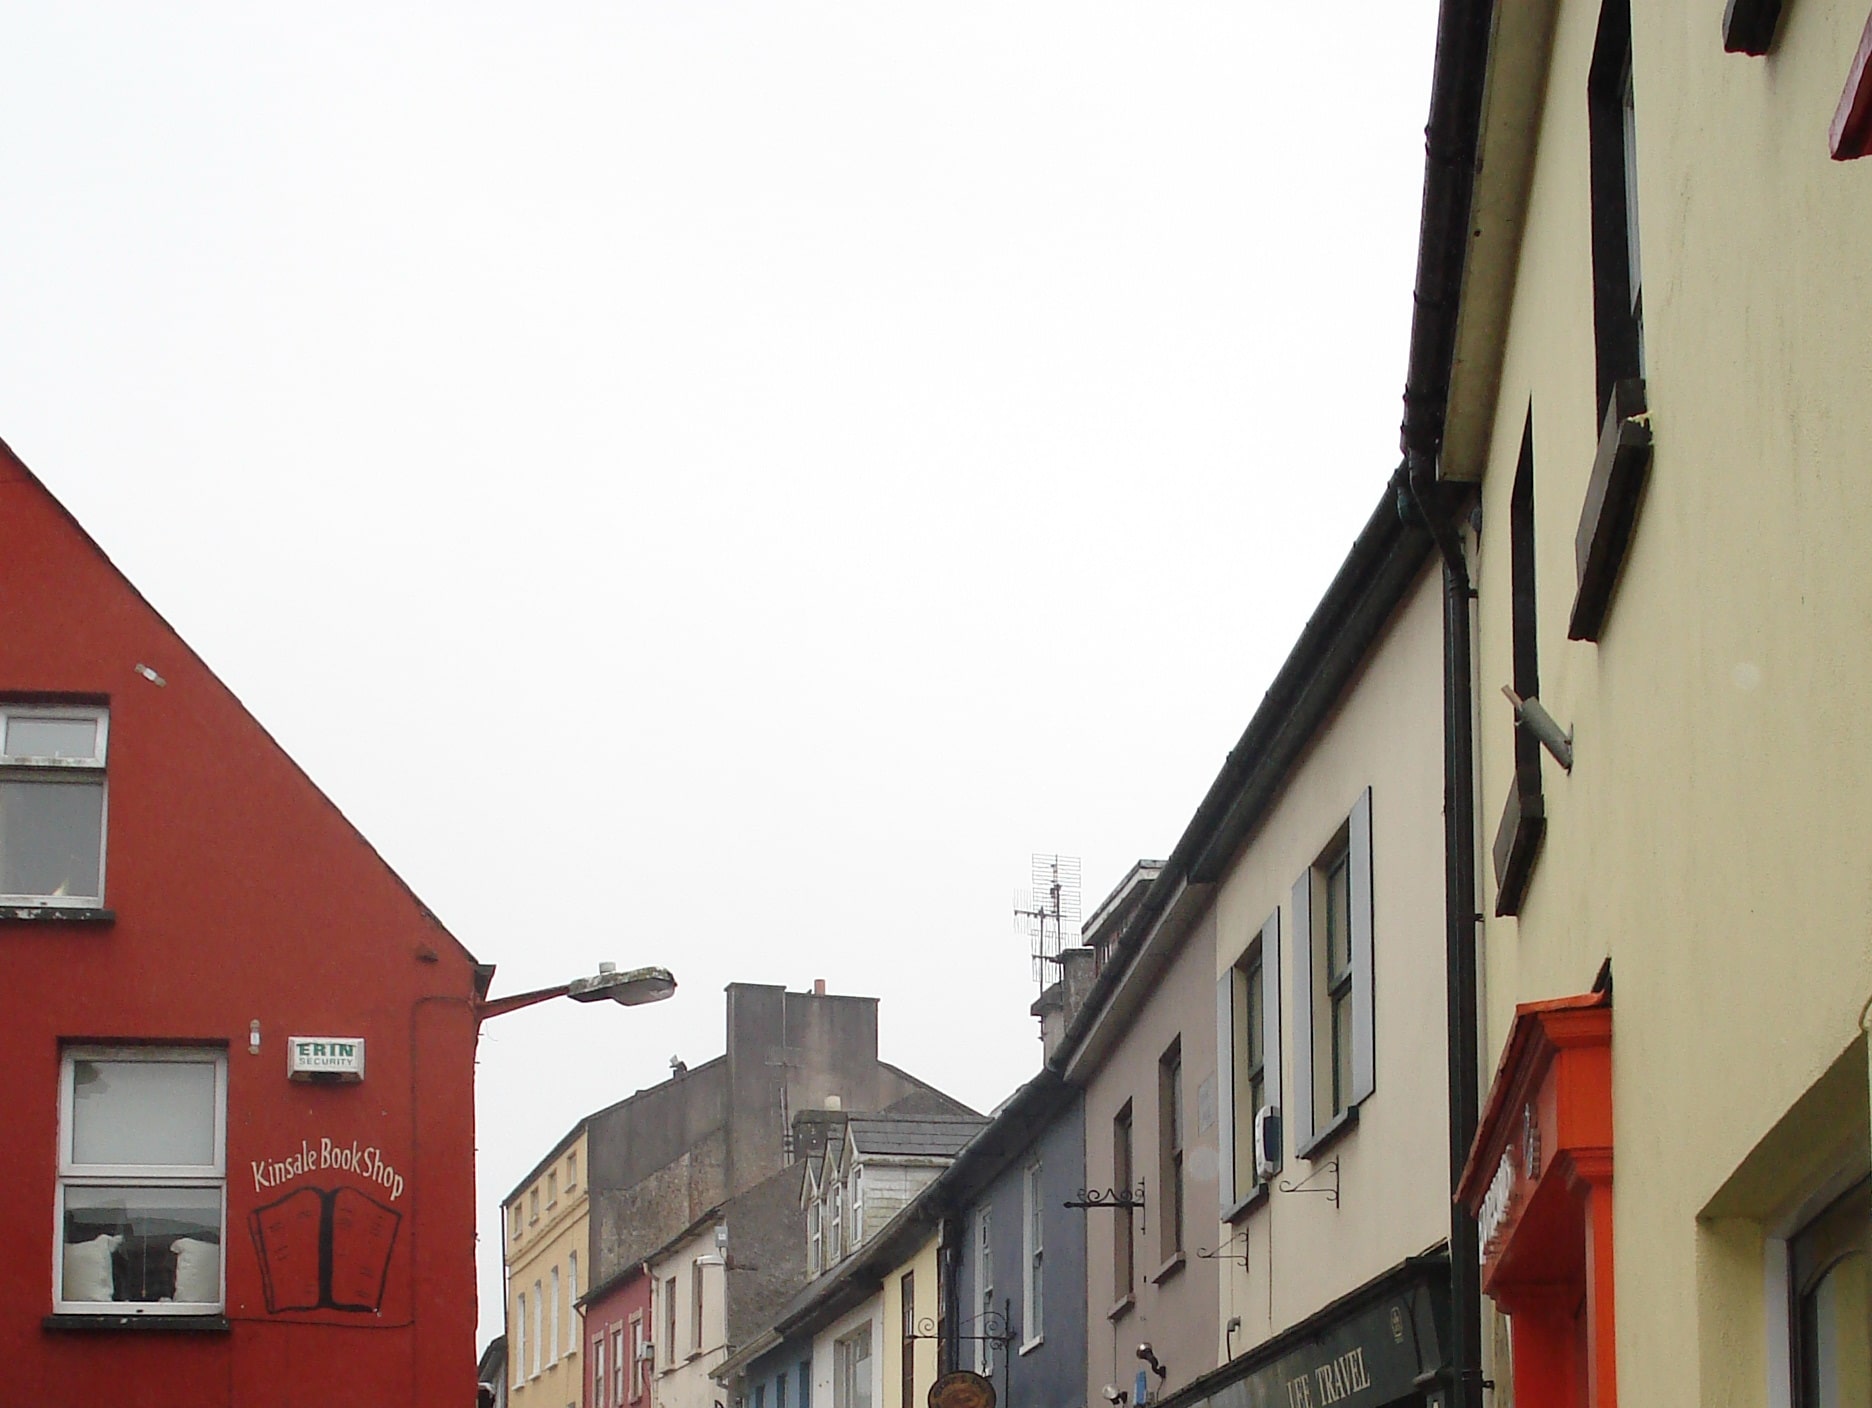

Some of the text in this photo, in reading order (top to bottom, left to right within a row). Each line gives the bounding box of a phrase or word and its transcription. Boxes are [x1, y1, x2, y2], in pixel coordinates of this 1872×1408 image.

[296, 1043, 357, 1057] ERIN
[299, 1057, 354, 1067] SECURITY
[251, 1140, 318, 1193] Kinsale
[1315, 1346, 1371, 1407] TRAVEL
